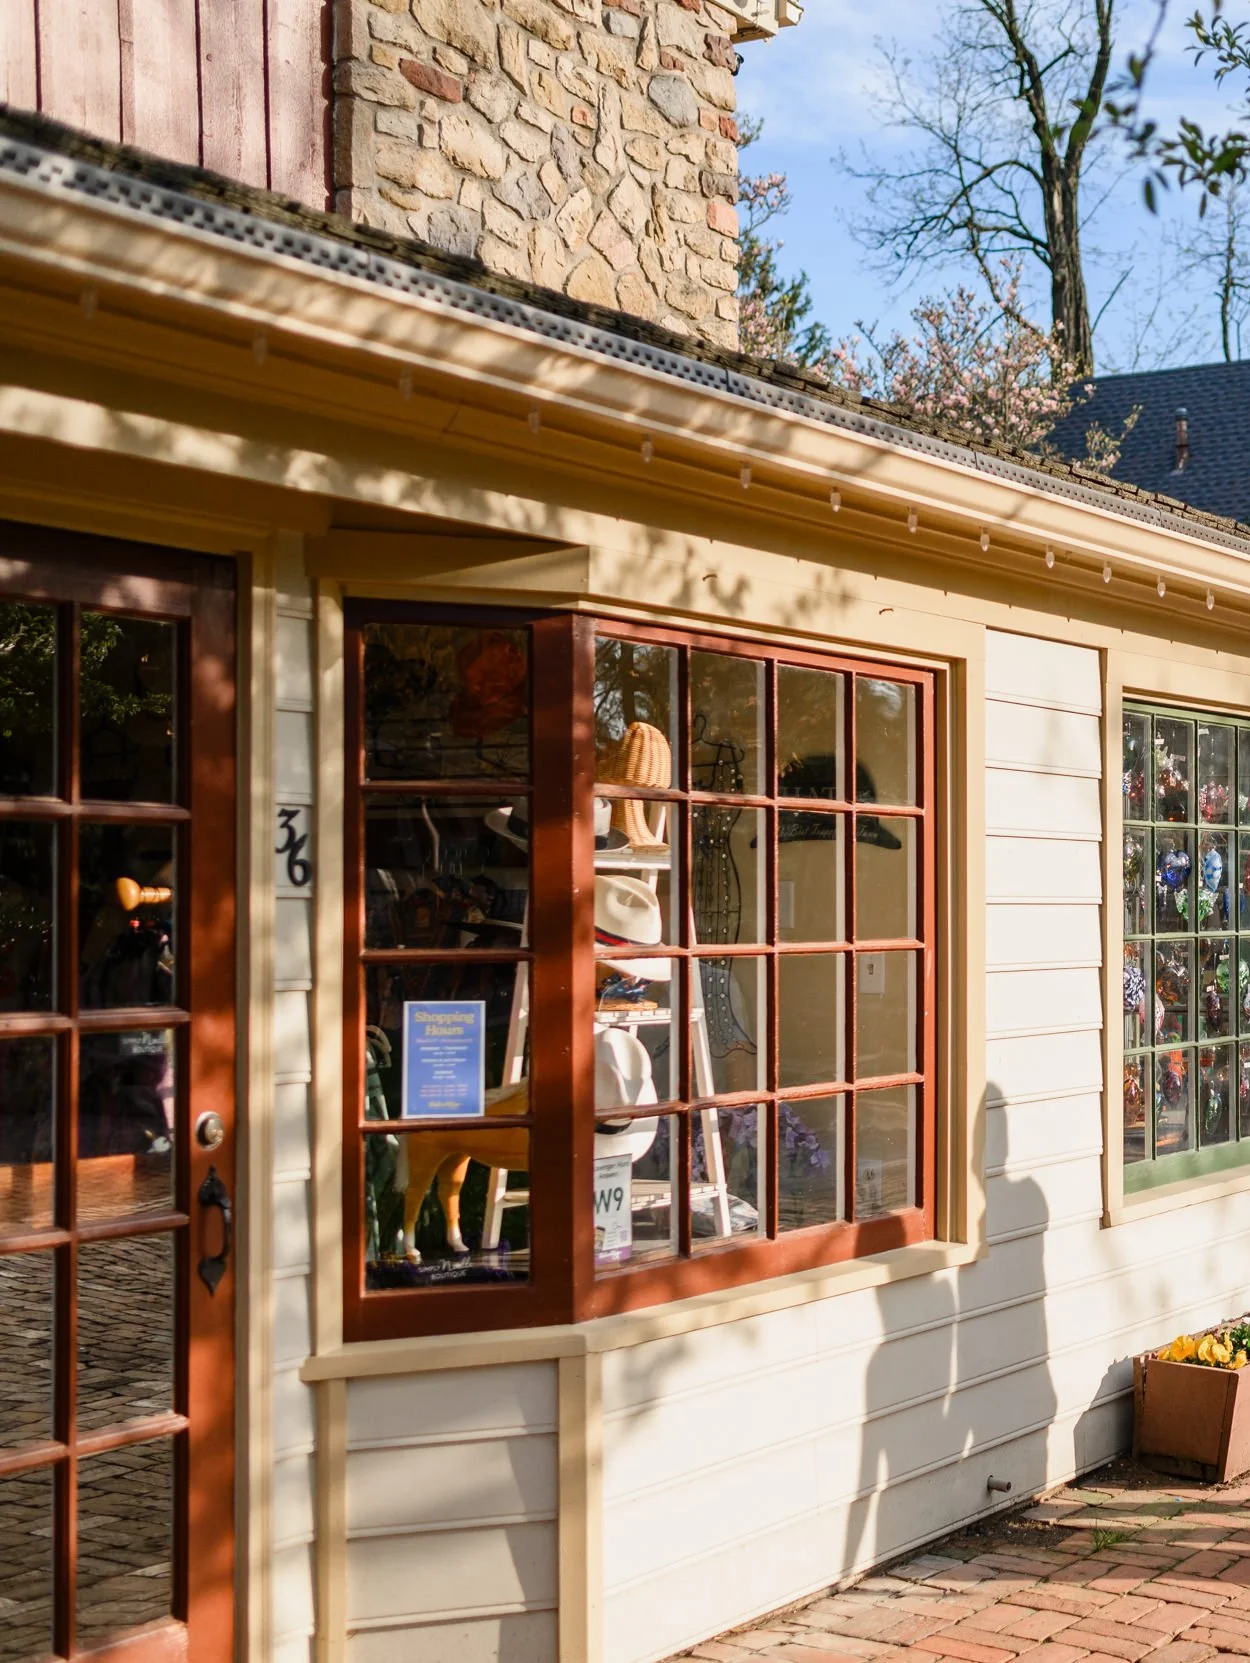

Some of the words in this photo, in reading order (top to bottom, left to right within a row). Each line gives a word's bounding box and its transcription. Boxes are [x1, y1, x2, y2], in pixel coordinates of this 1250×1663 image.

[275, 808, 313, 887] 36
[415, 1011, 475, 1025] Shopping
[424, 1025, 465, 1036] Hours
[594, 1186, 624, 1214] W9
